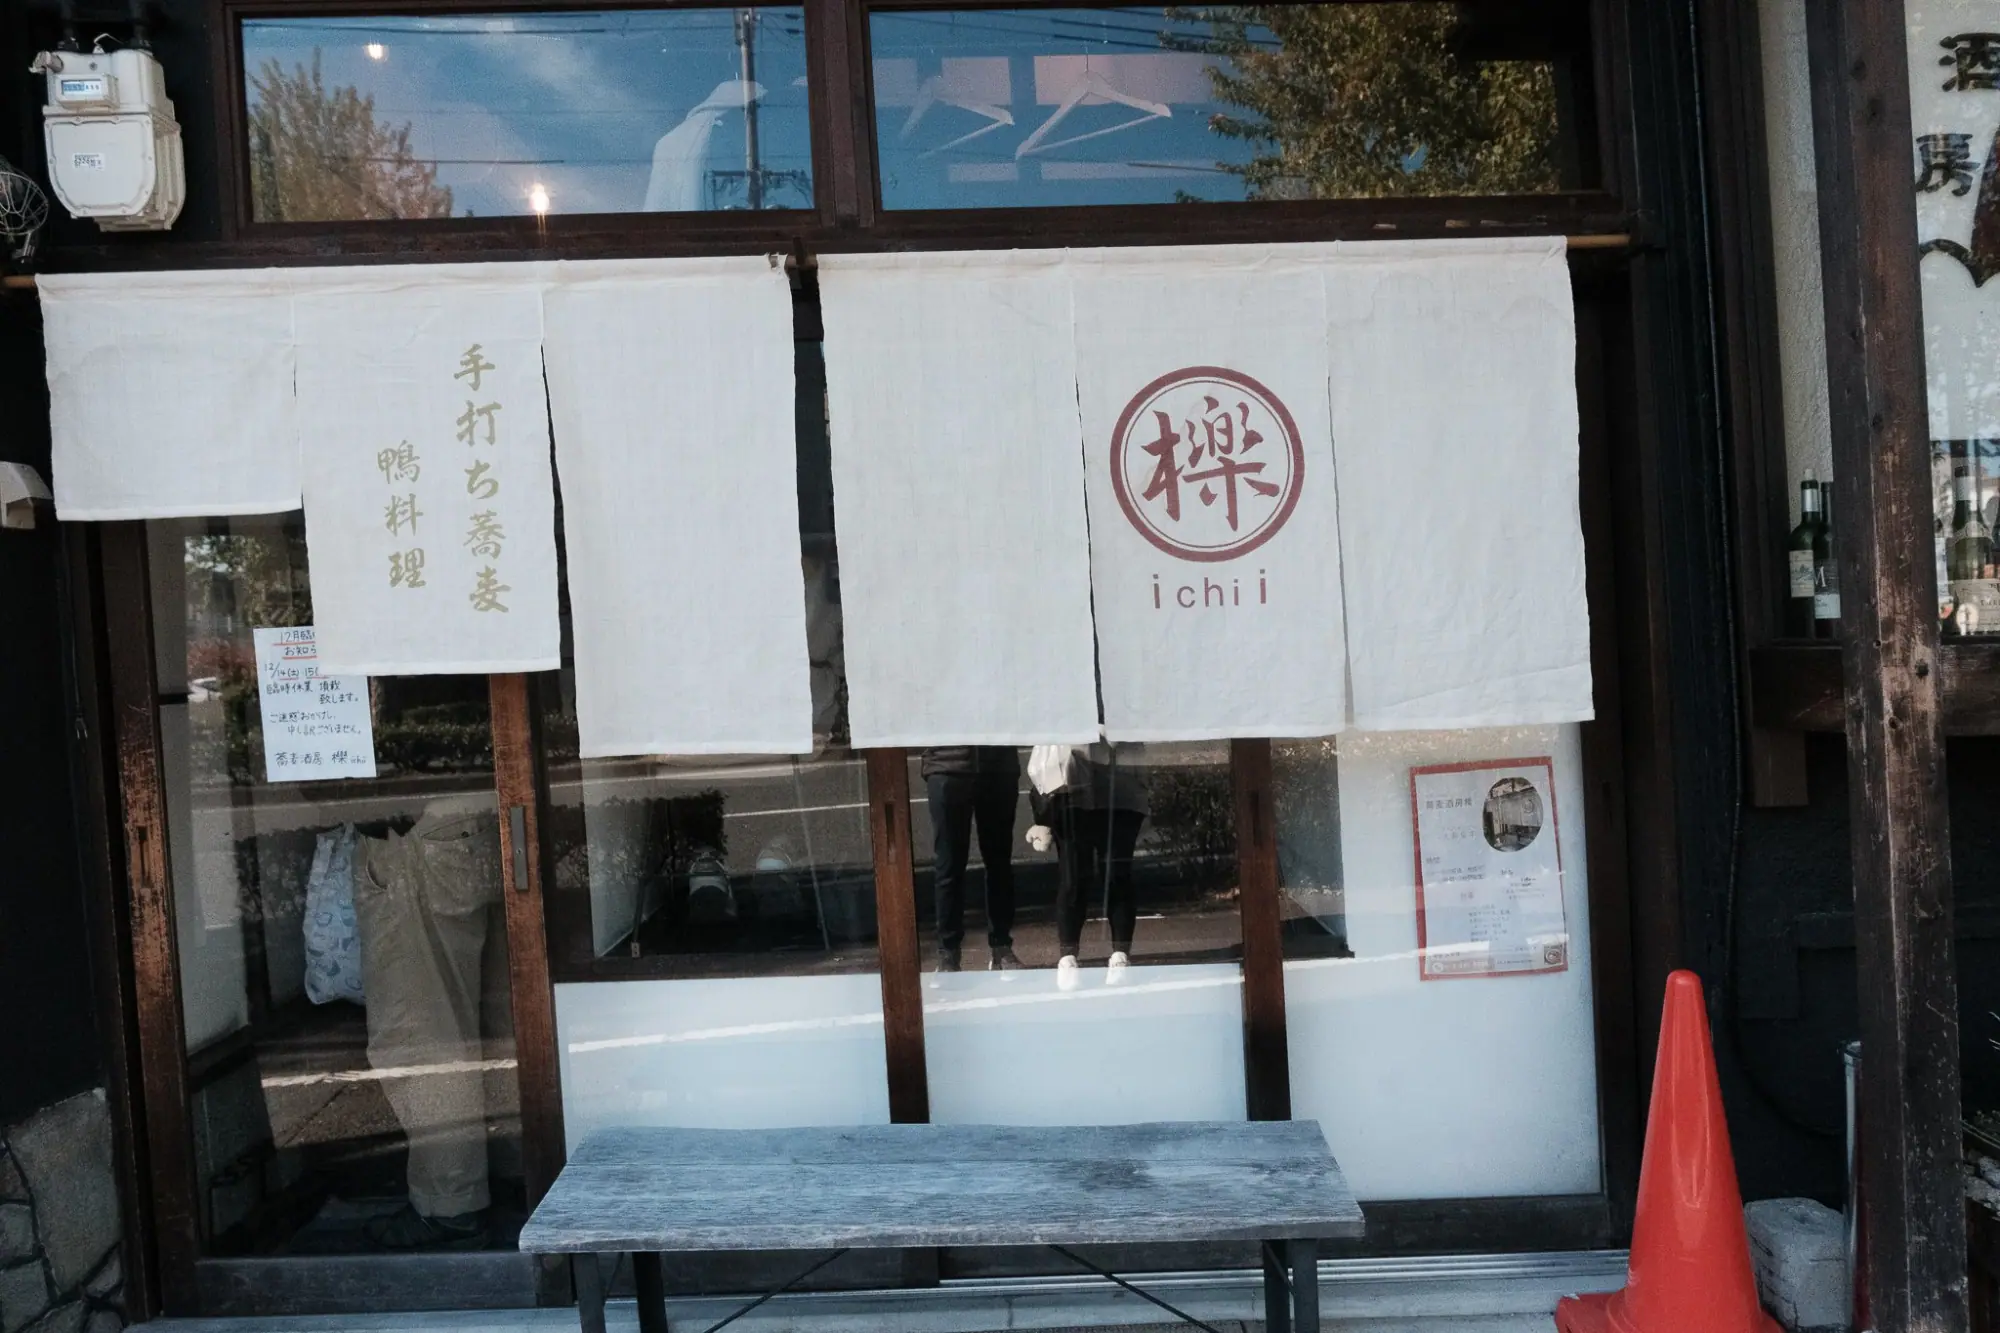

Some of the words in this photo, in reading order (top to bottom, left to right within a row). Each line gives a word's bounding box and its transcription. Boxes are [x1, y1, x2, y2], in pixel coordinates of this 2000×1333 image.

[377, 440, 426, 589] 鴨料理
[453, 343, 511, 613] 手打ち蕎麦
[1140, 395, 1280, 532] 櫟
[280, 629, 315, 644] 12月臨
[1152, 568, 1267, 609] ichii
